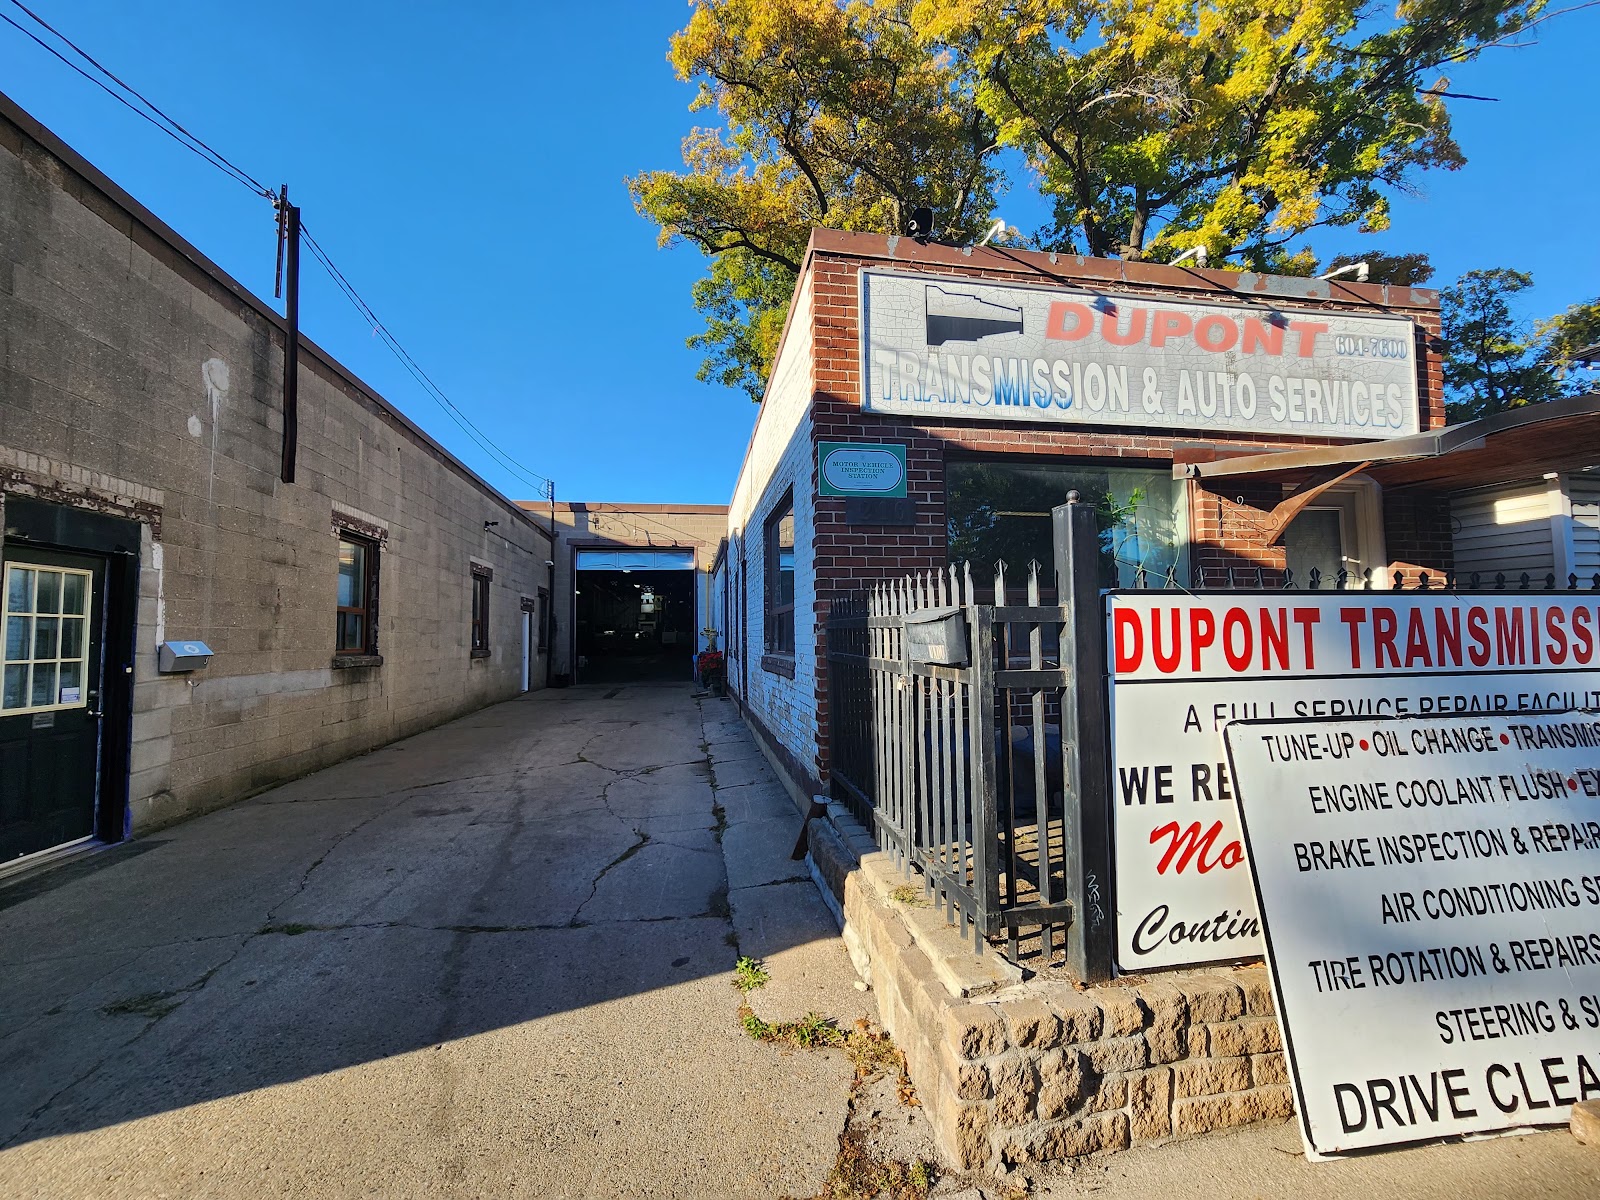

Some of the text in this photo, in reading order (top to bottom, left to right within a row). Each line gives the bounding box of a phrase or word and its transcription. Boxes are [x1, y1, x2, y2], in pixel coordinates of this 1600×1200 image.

[1045, 300, 1329, 359] DUPONT
[875, 349, 1404, 430] TRANSMISSION & AUTO SERVICES
[1113, 605, 1600, 674] DUPONT TRANSMISS
[1183, 704, 1202, 733] A
[1261, 732, 1355, 763] TUNE-UP
[1372, 729, 1409, 757] OIL
[1410, 726, 1499, 755] CHANGE
[1118, 763, 1233, 806] WE RE
[1308, 782, 1393, 815] ENGINE
[1396, 775, 1496, 809] COOLANT
[1498, 772, 1569, 802] FLUSH
[1149, 820, 1245, 876] Mo
[1293, 838, 1376, 873] BRAKE
[1376, 828, 1510, 866] INSPECTION
[1510, 826, 1530, 855] &
[1380, 891, 1421, 925] AIR
[1422, 877, 1581, 921] CONDITIONING
[1307, 956, 1367, 993] TIRE
[1367, 945, 1488, 987] ROTATION
[1489, 942, 1511, 974] &
[1435, 999, 1556, 1045] STEERING
[1558, 997, 1580, 1031] &
[1332, 1067, 1479, 1135] DRIVE
